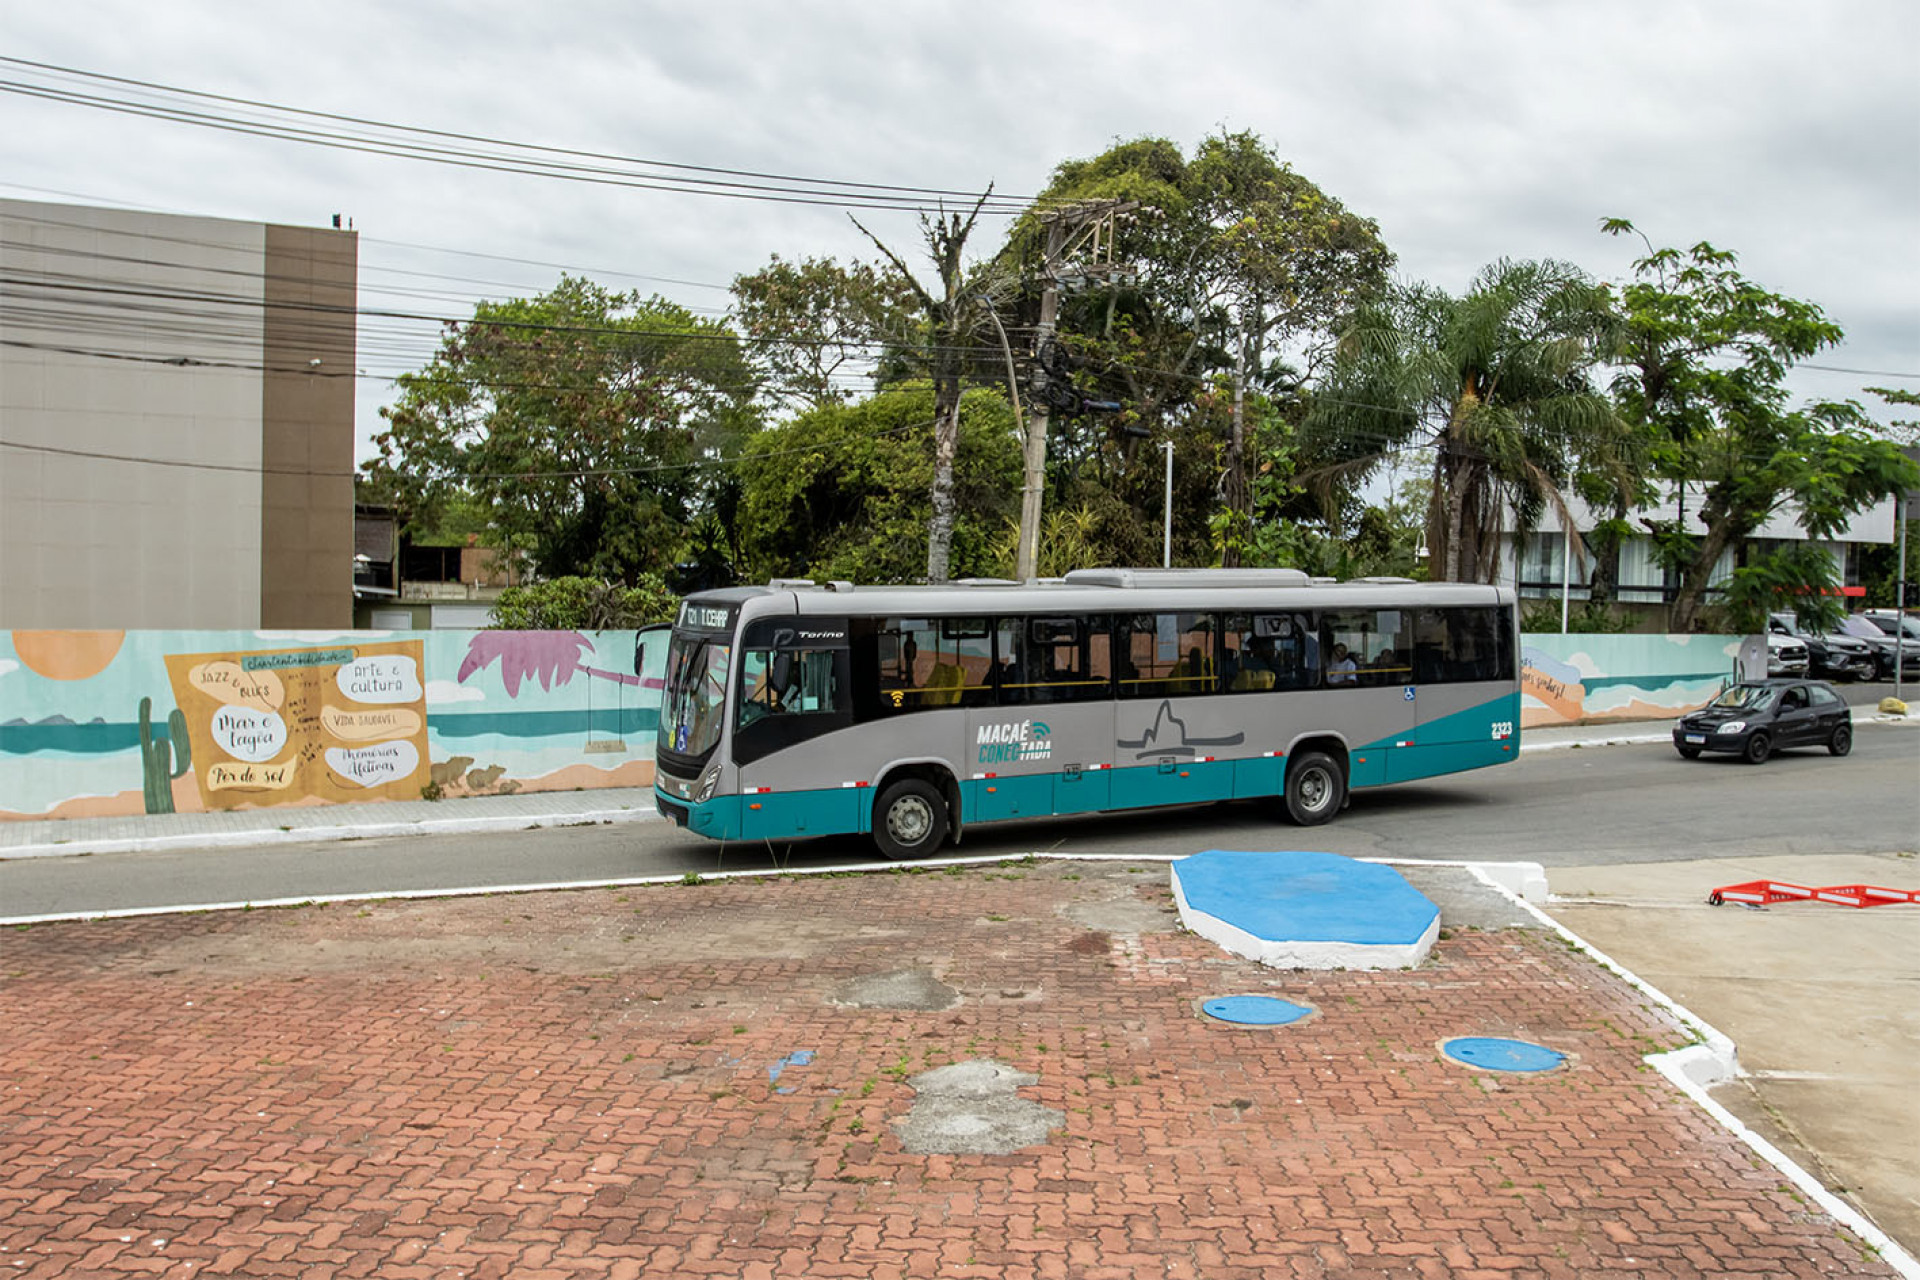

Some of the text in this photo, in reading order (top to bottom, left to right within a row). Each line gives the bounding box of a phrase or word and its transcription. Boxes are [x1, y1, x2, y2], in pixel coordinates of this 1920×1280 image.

[798, 630, 844, 639] Torino
[218, 714, 256, 731] Mar
[333, 714, 355, 727] VIDA
[977, 719, 1030, 744] MACAÉ
[1491, 721, 1513, 735] 2323
